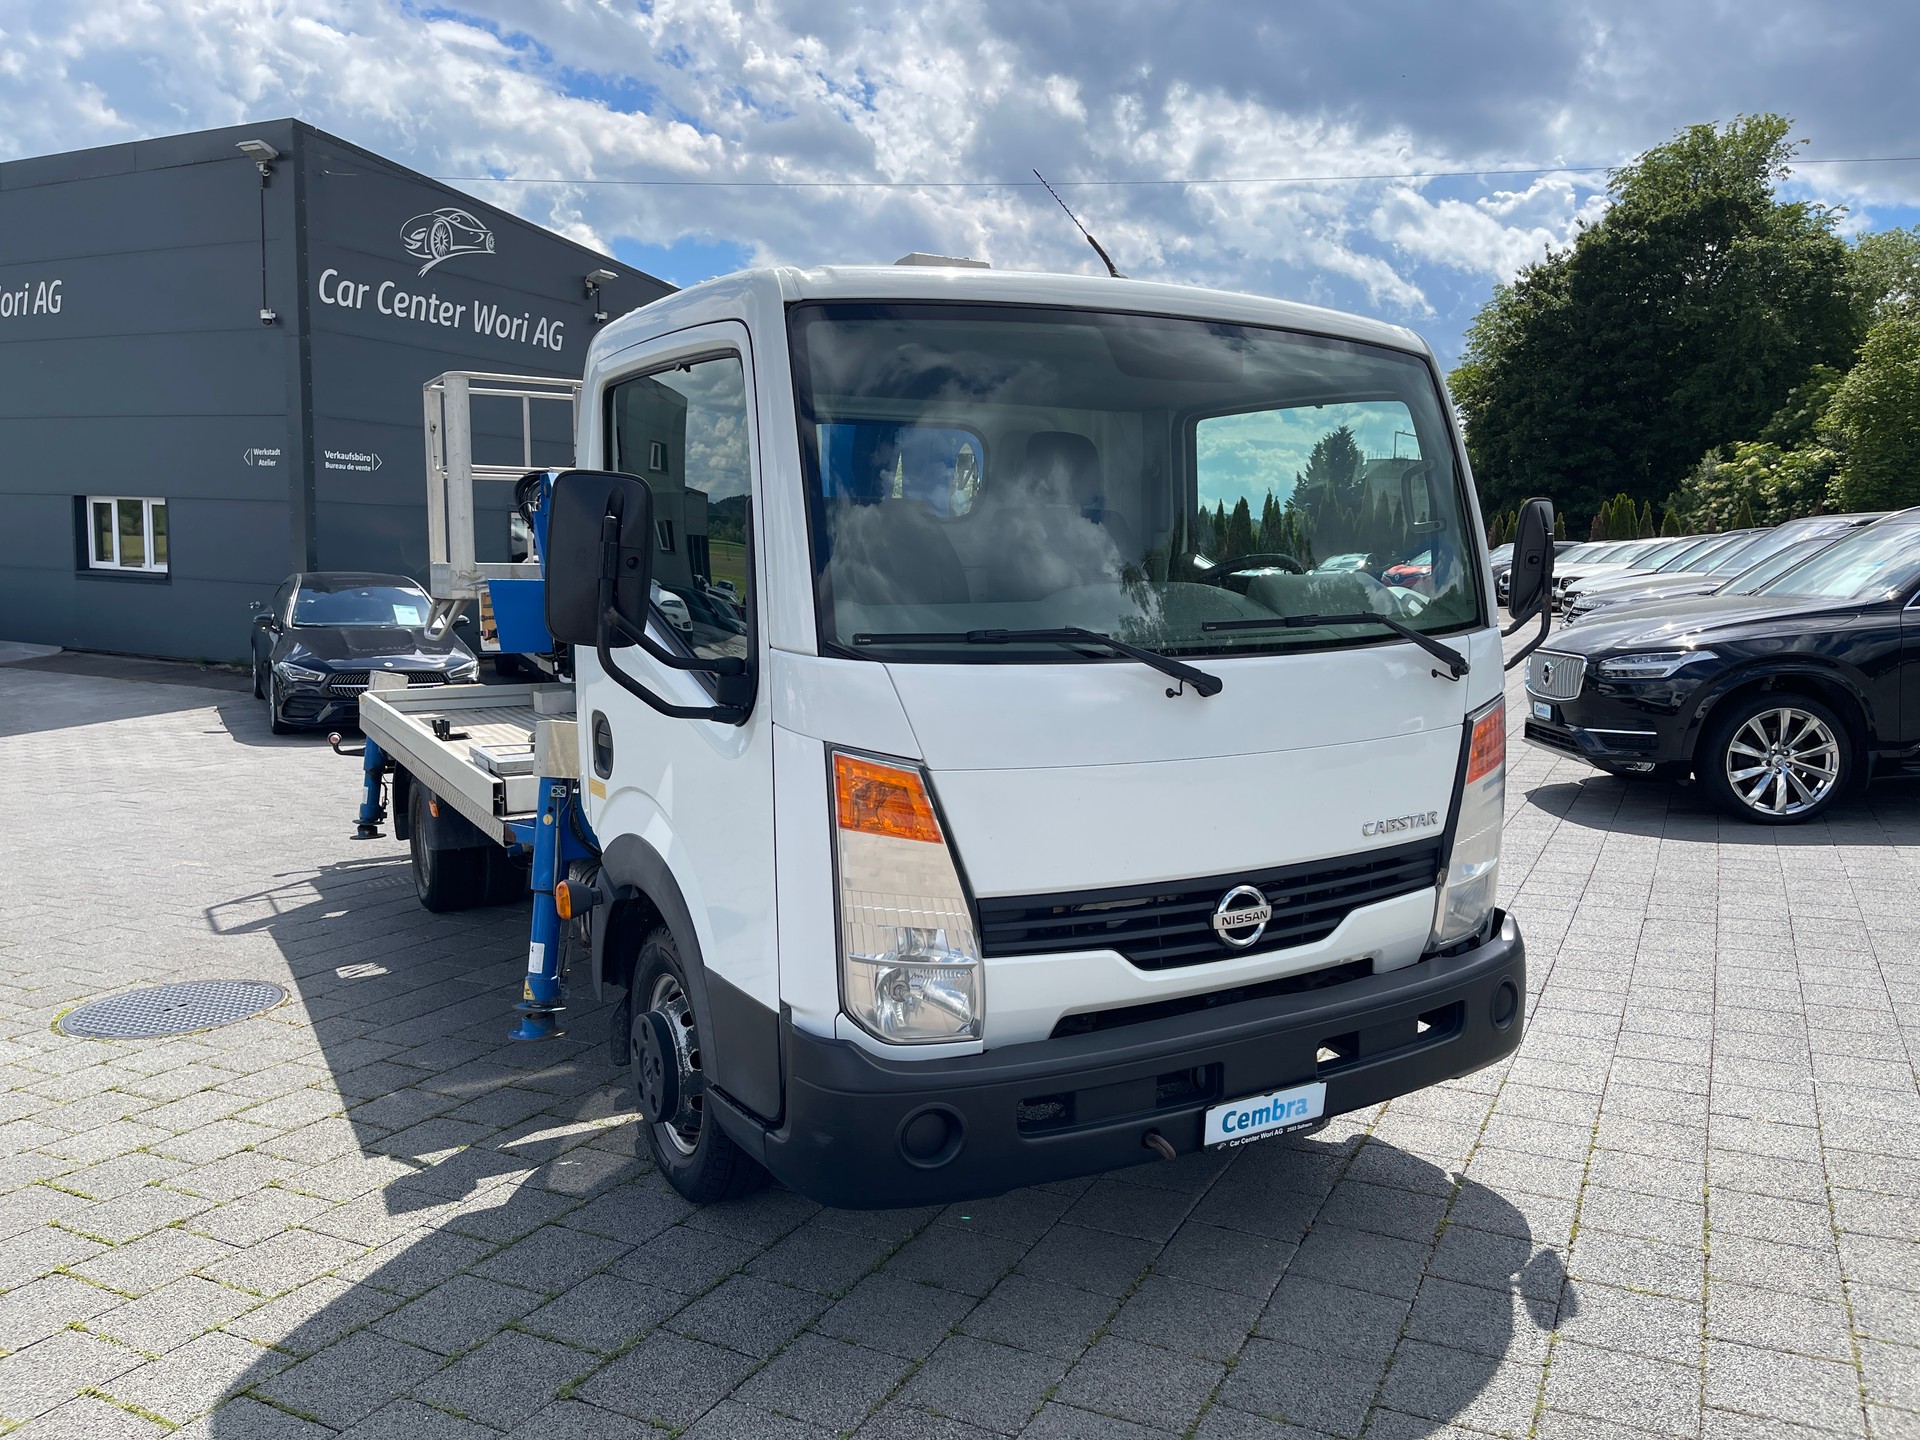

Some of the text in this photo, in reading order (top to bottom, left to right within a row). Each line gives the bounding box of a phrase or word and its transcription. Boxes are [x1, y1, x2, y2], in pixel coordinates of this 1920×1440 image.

[0, 279, 62, 317] ori AG
[318, 268, 564, 351] Car Center Wori AG
[324, 450, 371, 462] Verkaufsbüro
[325, 461, 347, 470] Bureau
[347, 462, 354, 471] de
[1362, 811, 1438, 837] CABSTAR
[1221, 909, 1268, 926] NISSAN
[1222, 1098, 1308, 1133] Cembra
[1229, 1139, 1240, 1147] Car
[1241, 1135, 1260, 1144] Center
[1261, 1131, 1274, 1139] Wori
[1275, 1128, 1284, 1136] AG
